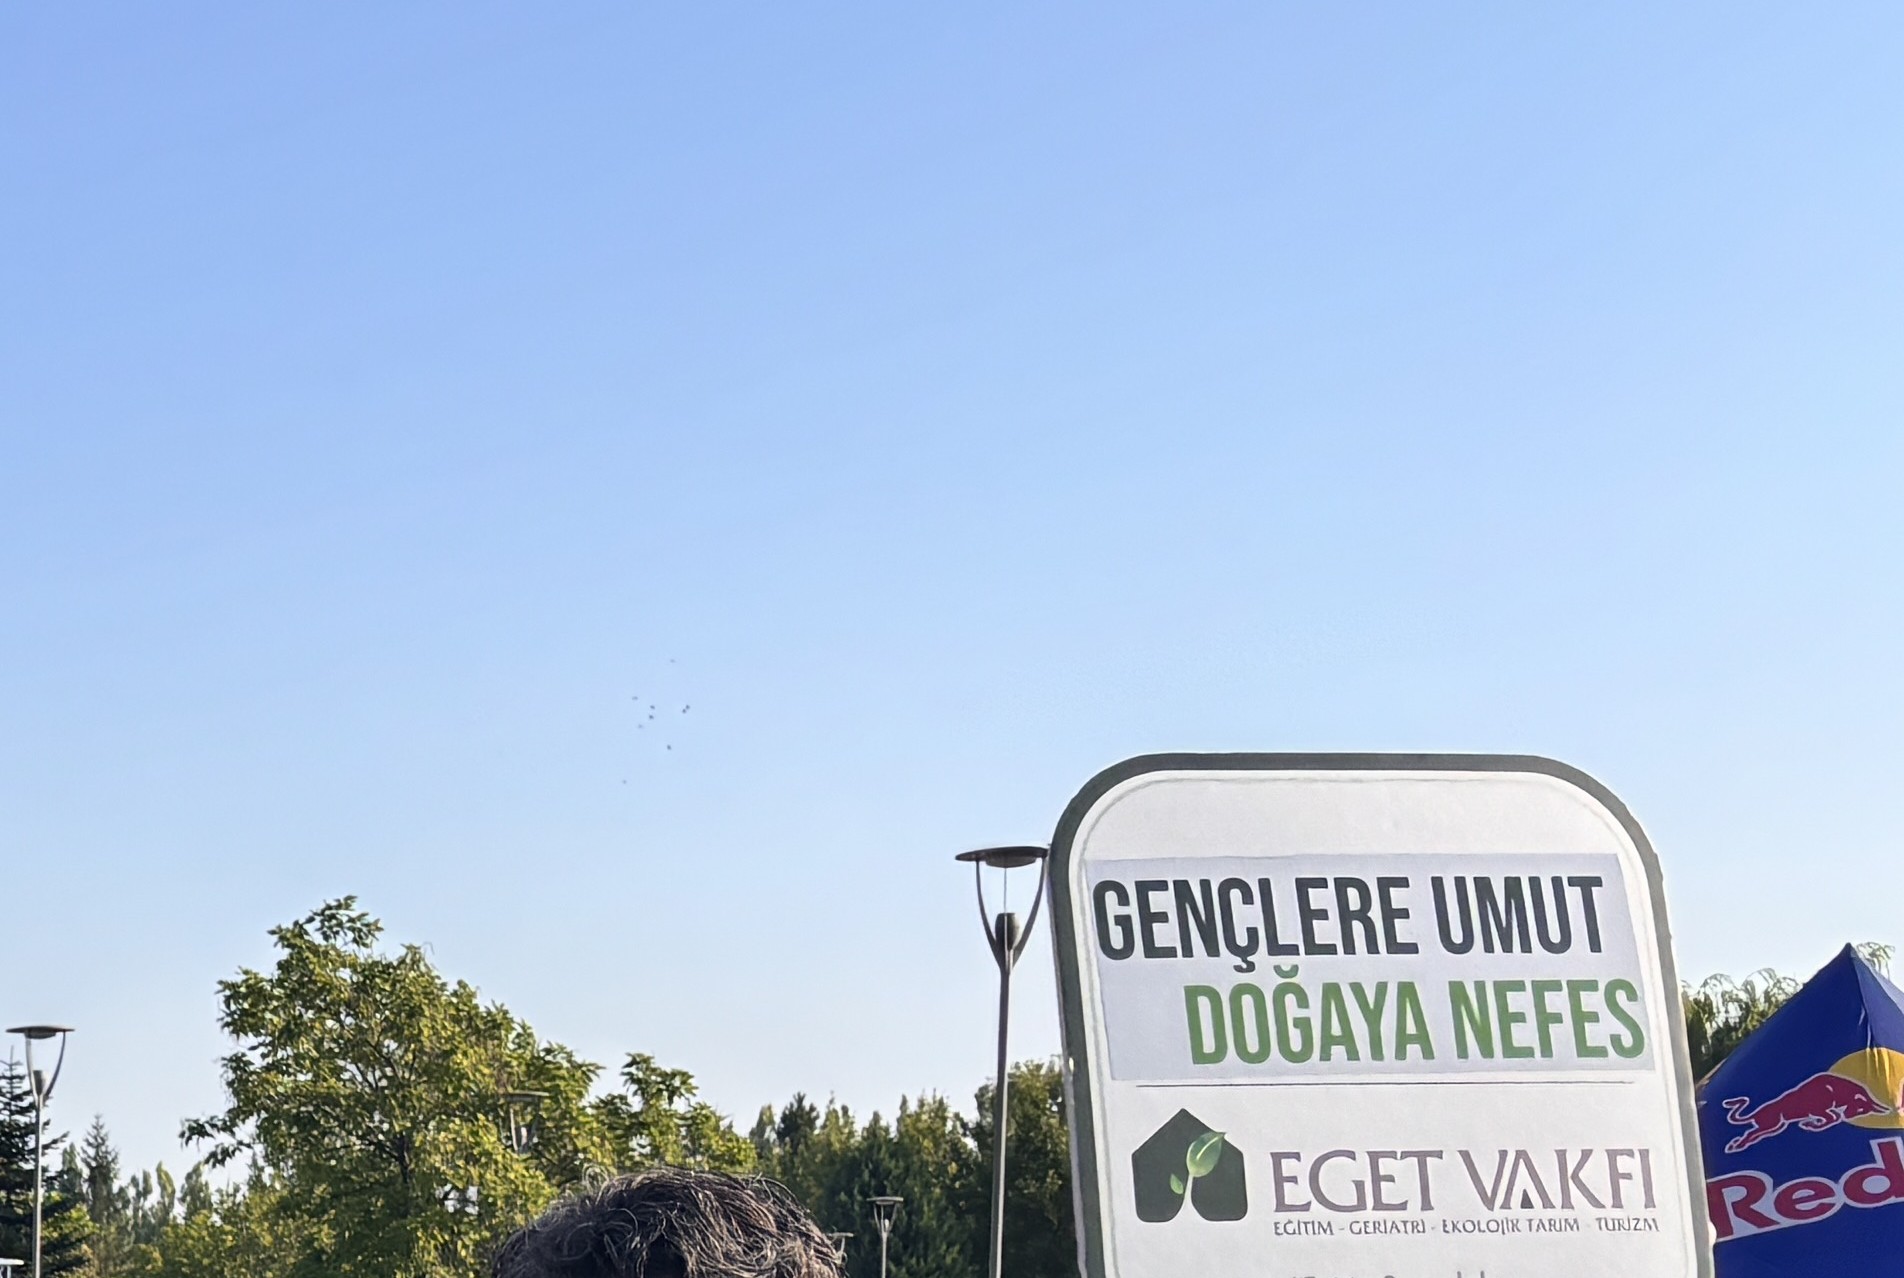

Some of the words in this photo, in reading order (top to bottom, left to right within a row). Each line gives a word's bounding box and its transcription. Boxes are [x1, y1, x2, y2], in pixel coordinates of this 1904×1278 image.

[1093, 877, 1418, 973] GENÇLERE
[1428, 875, 1603, 955] UMUT
[1183, 964, 1434, 1065] DOĞAYA
[1451, 978, 1644, 1060] NEFES
[1270, 1150, 1443, 1212] EGET
[1457, 1149, 1656, 1210] VAKFI
[1527, 1218, 1580, 1233] TARIM
[1707, 1138, 1904, 1241] Red
